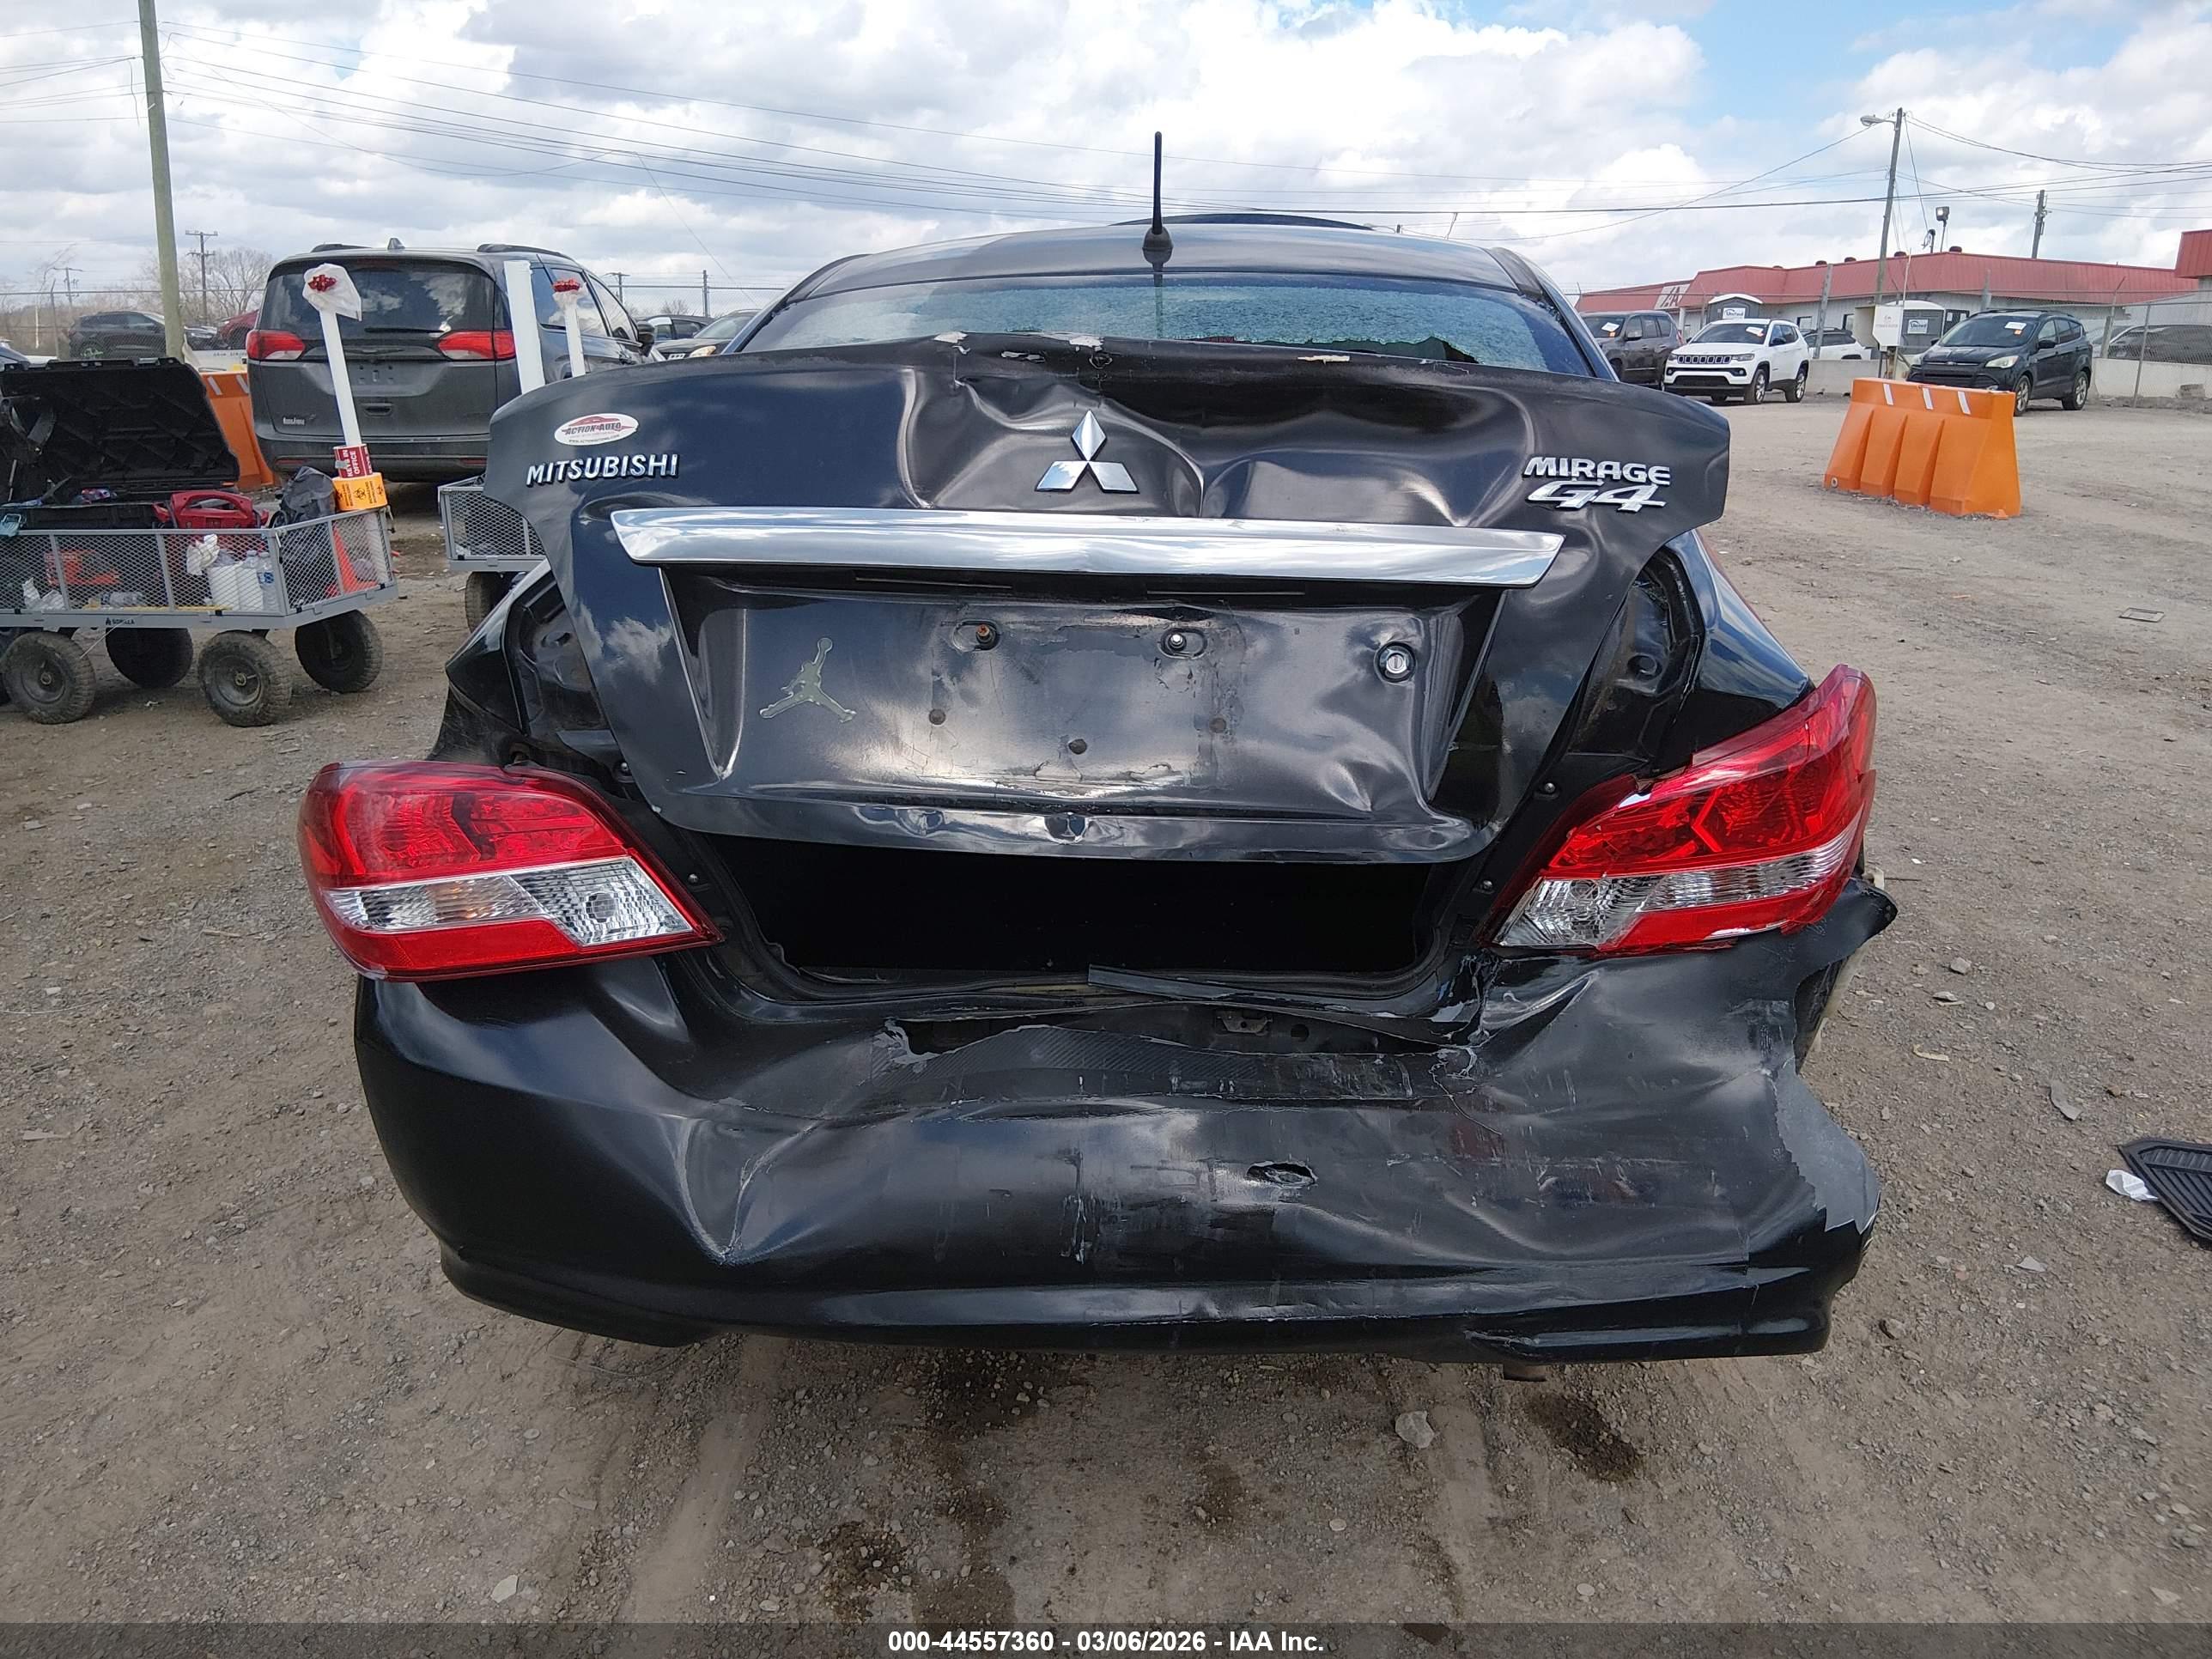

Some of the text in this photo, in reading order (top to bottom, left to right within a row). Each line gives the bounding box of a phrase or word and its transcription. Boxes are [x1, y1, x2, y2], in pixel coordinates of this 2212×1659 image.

[565, 424, 599, 435] ACTION
[599, 422, 622, 432] AUTO
[343, 449, 349, 458] IN
[349, 451, 360, 474] OFFICE
[344, 459, 354, 477] KEYS
[526, 453, 679, 486] MITSUBISHI
[1522, 456, 1671, 486] MIRAGE
[1526, 479, 1668, 513] G4
